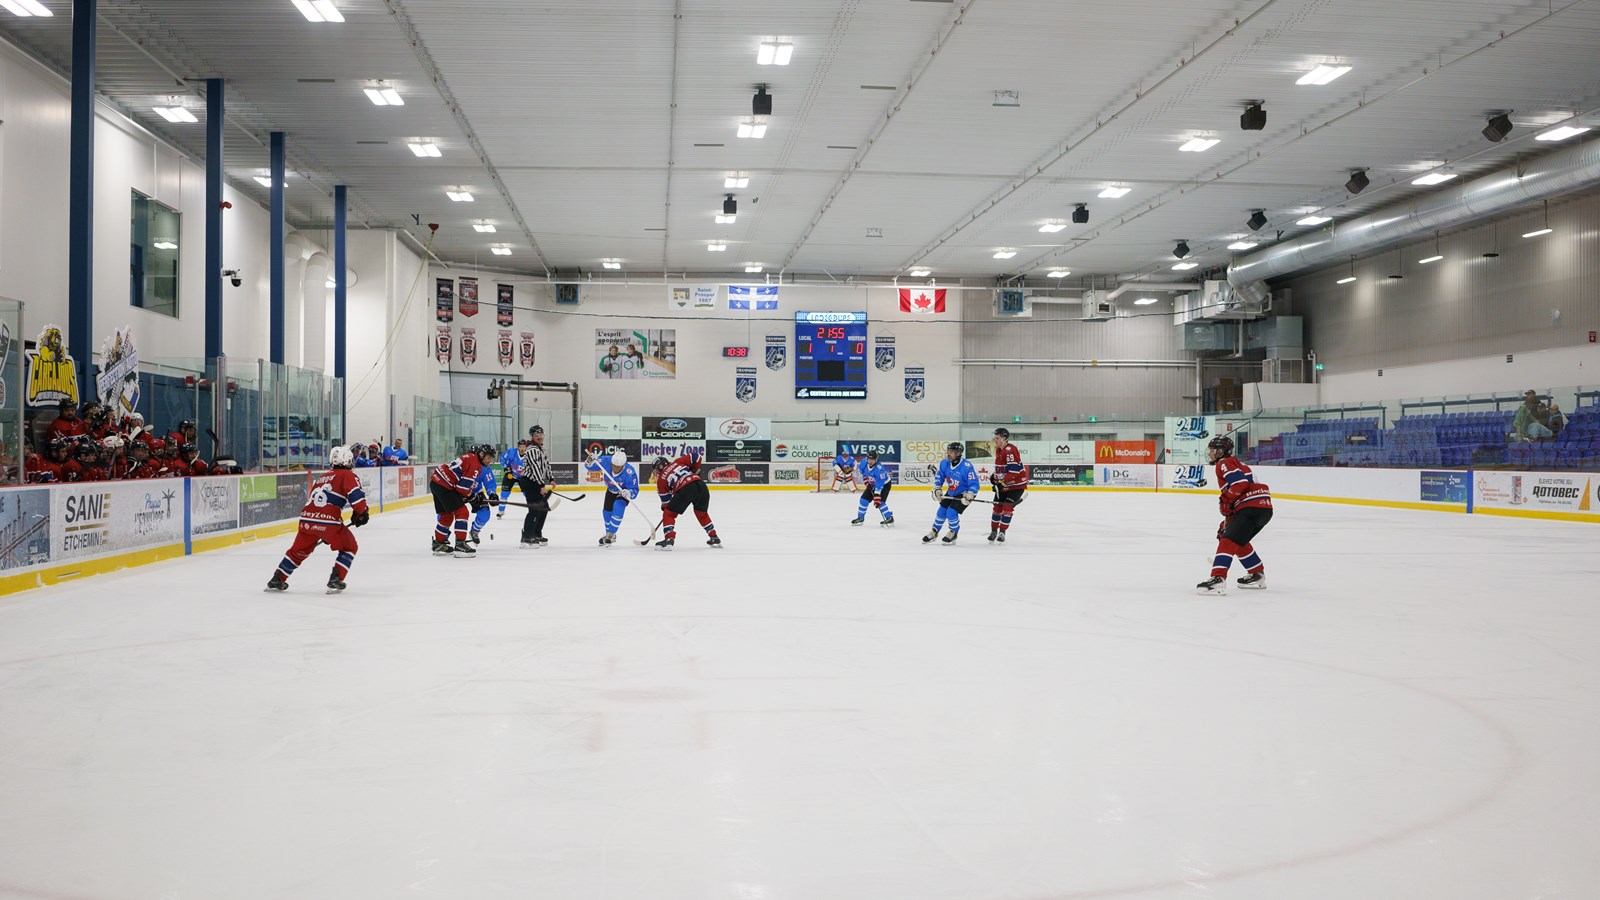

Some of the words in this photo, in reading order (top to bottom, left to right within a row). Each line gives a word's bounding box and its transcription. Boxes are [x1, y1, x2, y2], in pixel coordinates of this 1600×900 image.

[817, 327, 845, 339] 21:55
[727, 347, 747, 357] 10:38
[808, 342, 813, 353] 1
[830, 345, 834, 353] 1
[856, 342, 864, 354] 0
[664, 420, 684, 428] Ford
[642, 443, 678, 458] Hockey
[680, 442, 705, 457] Zone
[850, 444, 896, 454] VERSA
[906, 441, 948, 452] GESTIO
[791, 450, 834, 458] COULOMBE
[1115, 449, 1151, 457] McDonald's
[1221, 463, 1228, 472] 4
[1538, 477, 1553, 485] ÉLEVEZ
[1532, 485, 1580, 499] ROTOBEC
[65, 494, 103, 524] SANI
[64, 532, 100, 551] ETCHEMIN
